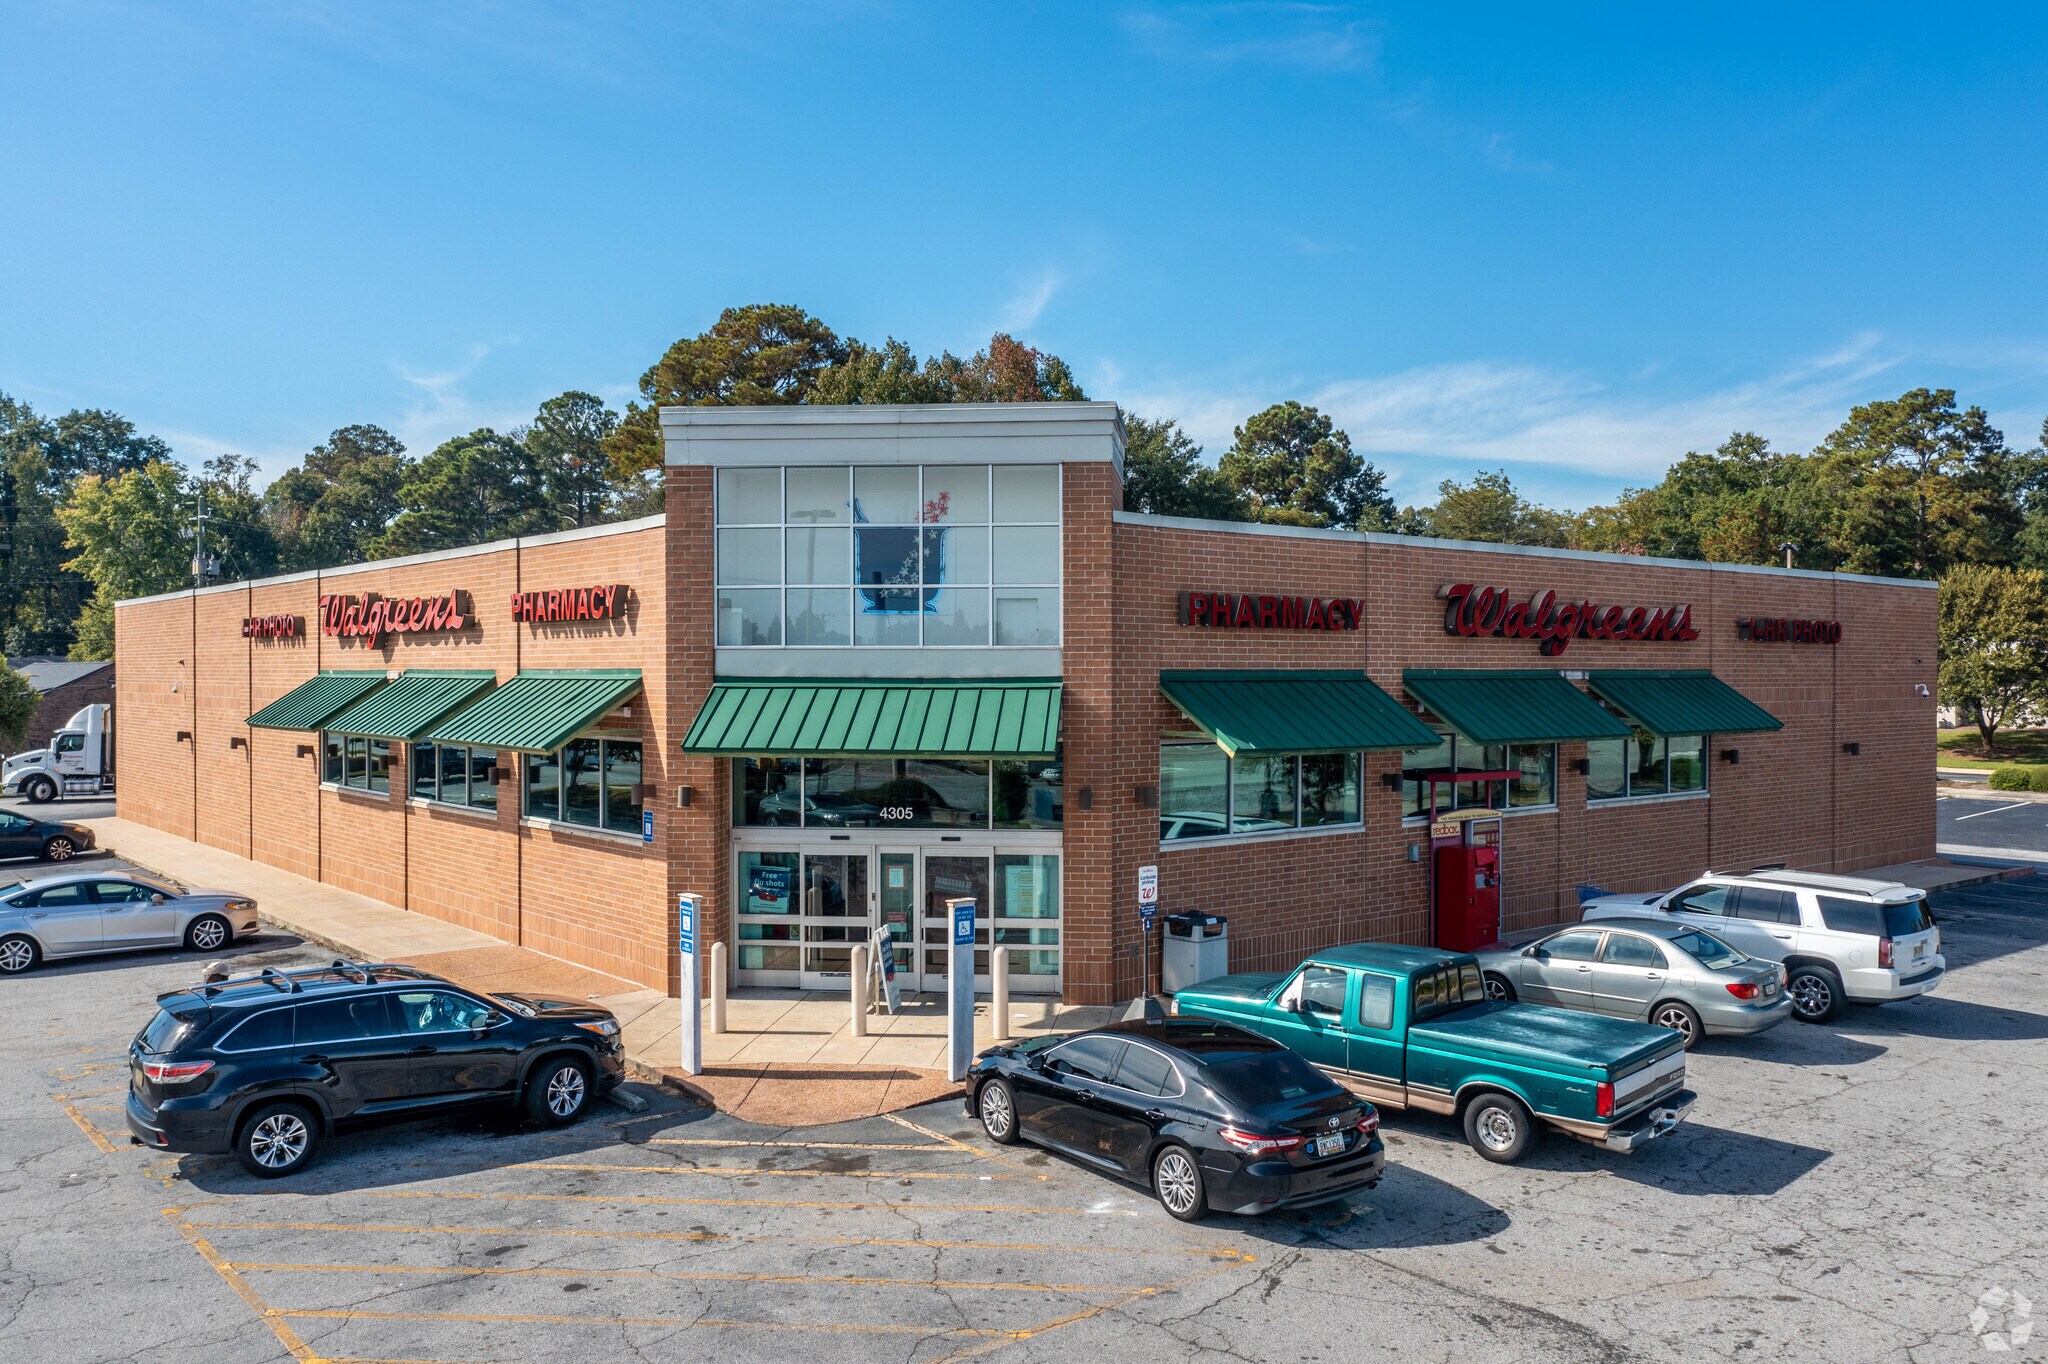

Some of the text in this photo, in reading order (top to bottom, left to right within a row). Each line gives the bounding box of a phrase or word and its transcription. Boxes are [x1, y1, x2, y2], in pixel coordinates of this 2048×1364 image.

[511, 584, 617, 622] PHARMACY
[1189, 592, 1365, 632] PHARMACY
[263, 613, 295, 638] PHOTO
[318, 588, 465, 650] Walgreens
[1446, 583, 1701, 656] Walgreens
[1793, 619, 1842, 644] PHOTO
[880, 806, 914, 820] 4305
[754, 878, 785, 887] flu shots
[762, 871, 778, 880] Free
[1146, 920, 1151, 928] 1
[1669, 1068, 1685, 1081] FORD
